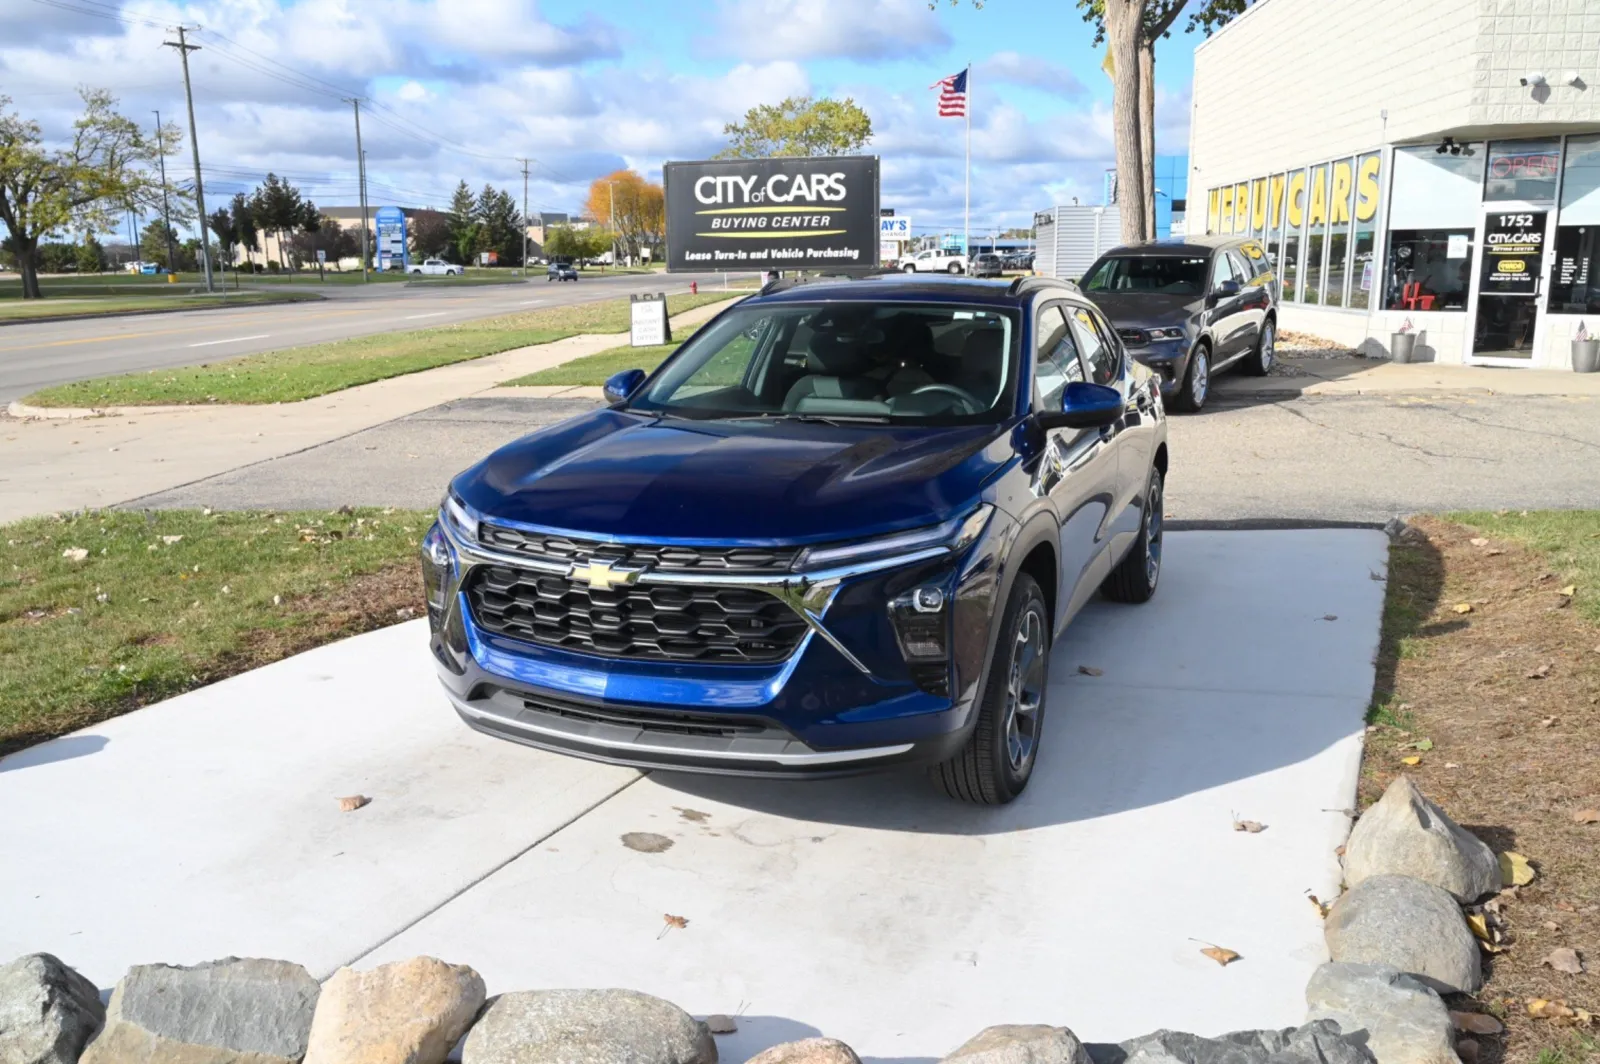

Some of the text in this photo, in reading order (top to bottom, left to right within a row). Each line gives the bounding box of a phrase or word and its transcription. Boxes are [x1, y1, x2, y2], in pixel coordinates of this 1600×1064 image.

[1493, 156, 1559, 177] OPEN
[694, 172, 847, 204] CITY of CARS
[1235, 174, 1284, 232] BUY
[1288, 156, 1381, 228] CARS
[711, 215, 831, 229] BUYING CENTER
[1500, 215, 1533, 227] 1752
[1488, 233, 1511, 243] CITY
[1513, 232, 1542, 243] CARS
[685, 247, 860, 261] Lease Turn-in and Vehicle Purchasing
